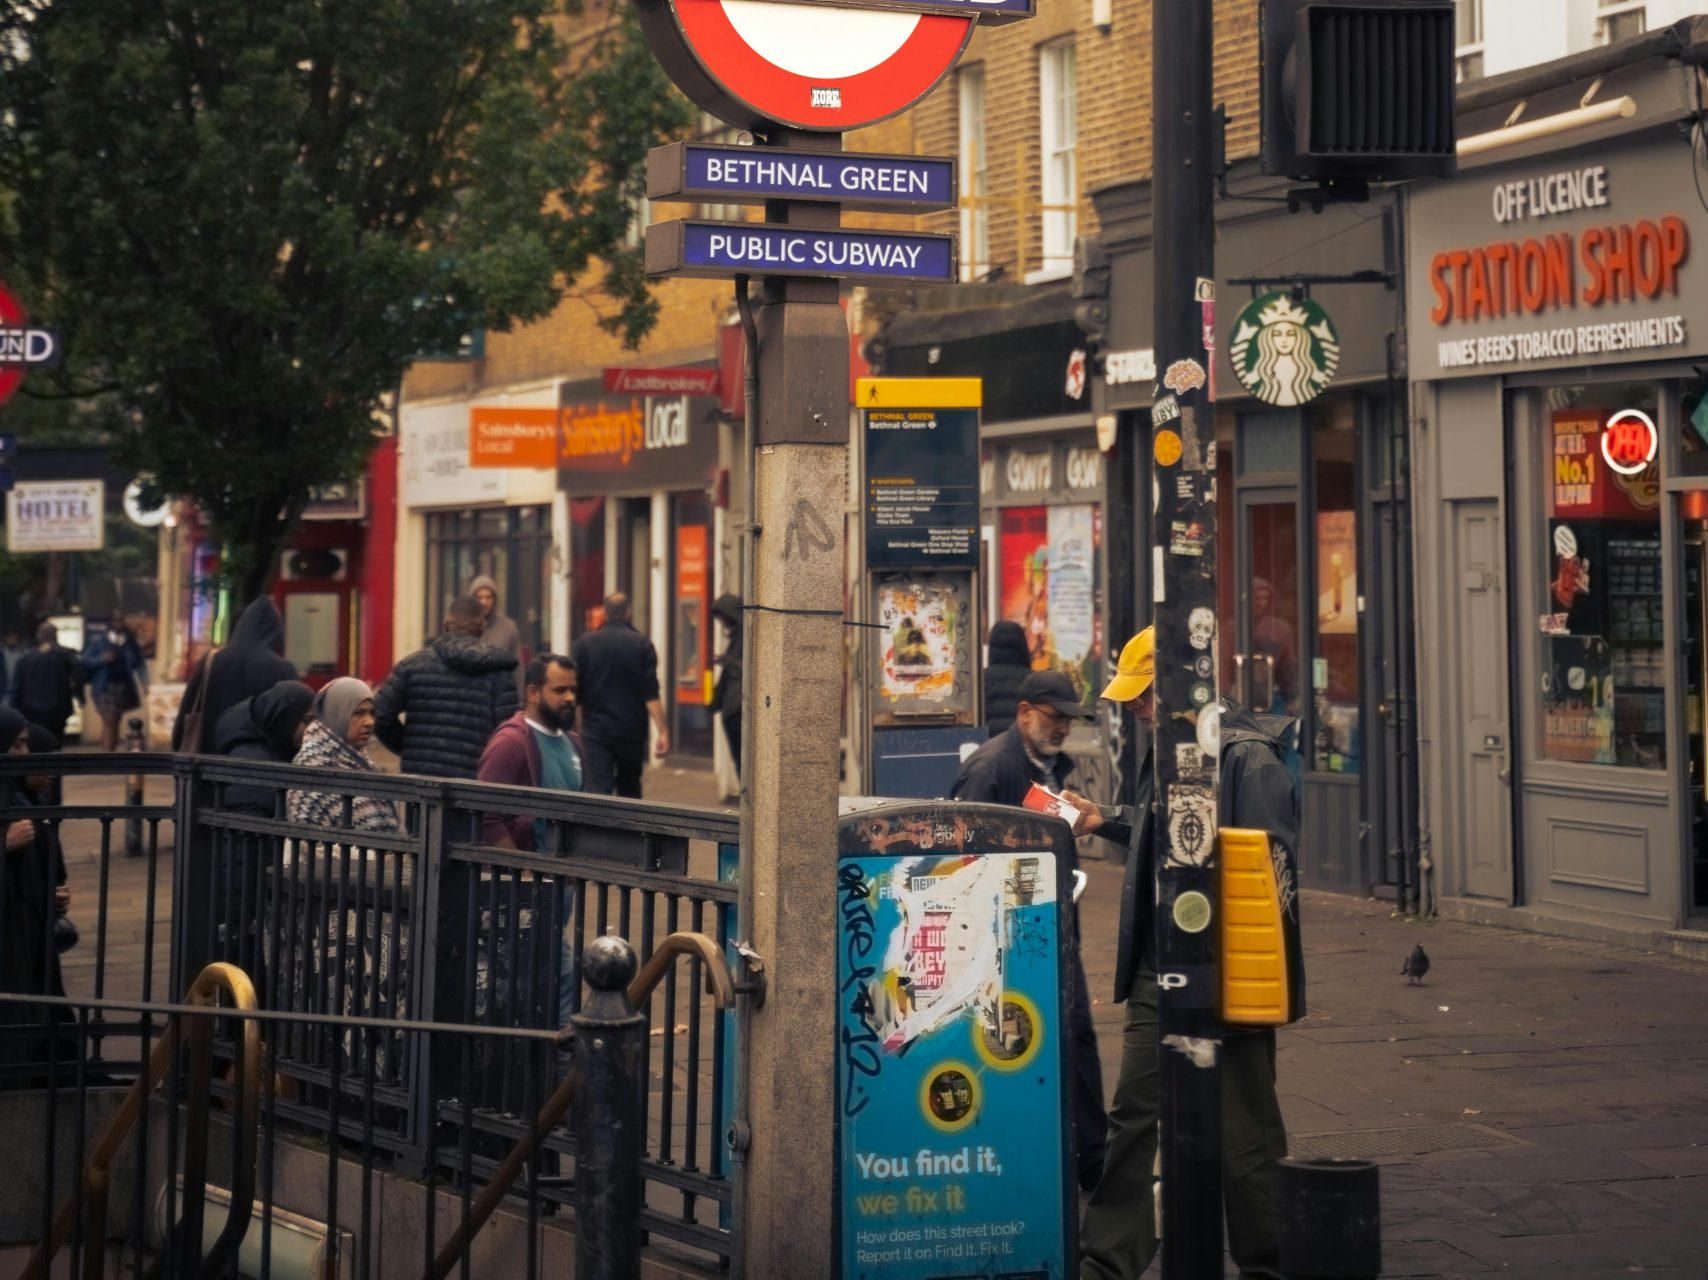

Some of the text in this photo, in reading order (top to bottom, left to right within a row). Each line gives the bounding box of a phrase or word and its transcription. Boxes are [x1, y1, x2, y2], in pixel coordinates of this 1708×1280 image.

[812, 89, 839, 106] KORE
[707, 158, 928, 194] BETHNAL GREEN
[1493, 166, 1607, 222] OFF LICENCE
[709, 235, 921, 269] PUBLIC SUBWAY
[1431, 216, 1687, 325] STATION SHOP
[1438, 316, 1683, 368] WINES BEERS TOBACCO REFRESHMENTS
[623, 377, 706, 391] Ladbrokes
[478, 423, 556, 441] Sainsbury's
[561, 395, 688, 464] Sainsbury's Local
[869, 413, 935, 421] BETHNAL GREEN
[478, 440, 513, 453] Local
[1608, 422, 1651, 461] OPEN
[1555, 454, 1595, 484] No.1
[17, 500, 93, 520] HOTEL
[856, 1146, 1004, 1179] You find it,
[856, 1185, 965, 1215] we fix it
[857, 1221, 1025, 1244] How does this street look?
[857, 1248, 902, 1264] Report
[904, 1246, 912, 1260] it
[915, 1250, 932, 1260] on
[935, 1243, 963, 1258] Find
[980, 1241, 999, 1255] Fix
